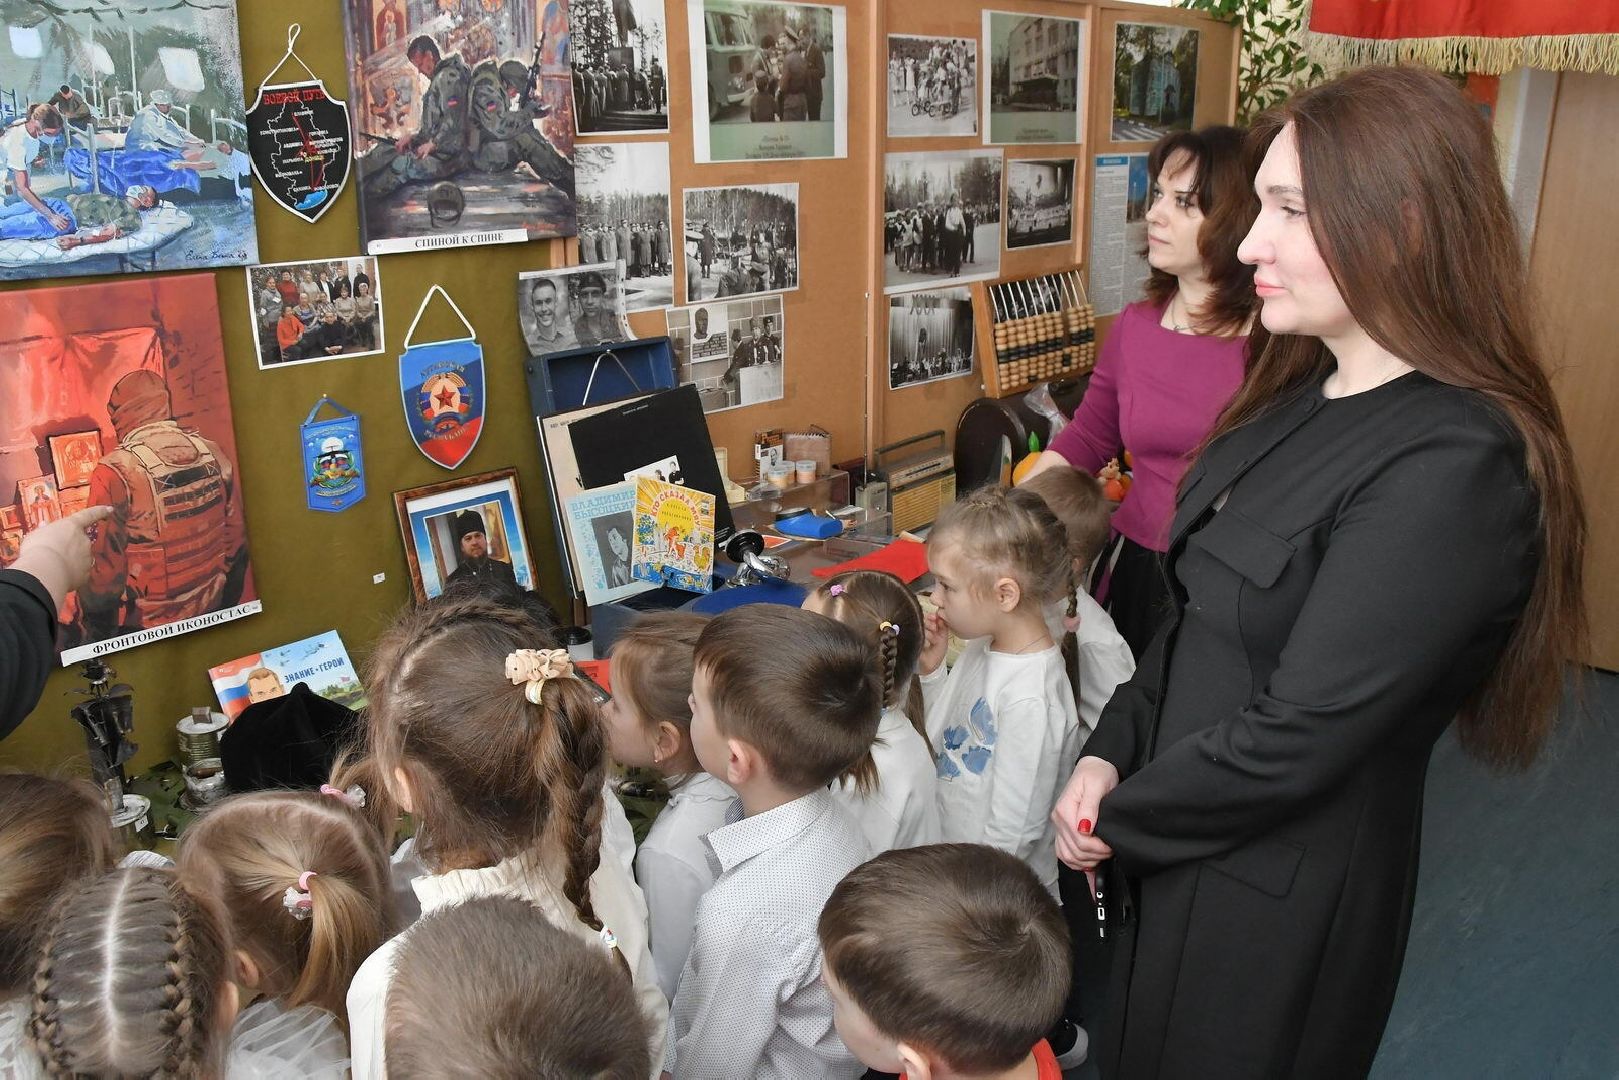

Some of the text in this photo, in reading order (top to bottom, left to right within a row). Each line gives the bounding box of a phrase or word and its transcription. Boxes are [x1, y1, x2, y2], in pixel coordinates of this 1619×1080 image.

[415, 232, 504, 248] СПИНОЙ К СПИНЕ
[571, 489, 635, 511] ВЛАДИМИР
[650, 500, 660, 517] КТО
[659, 490, 690, 505] СКАЗАЛ
[93, 605, 250, 654] ФРОНТОВОЙ ИКОНОСТАС
[284, 657, 345, 684] ЗНАНИЕ ГЕРОИ
